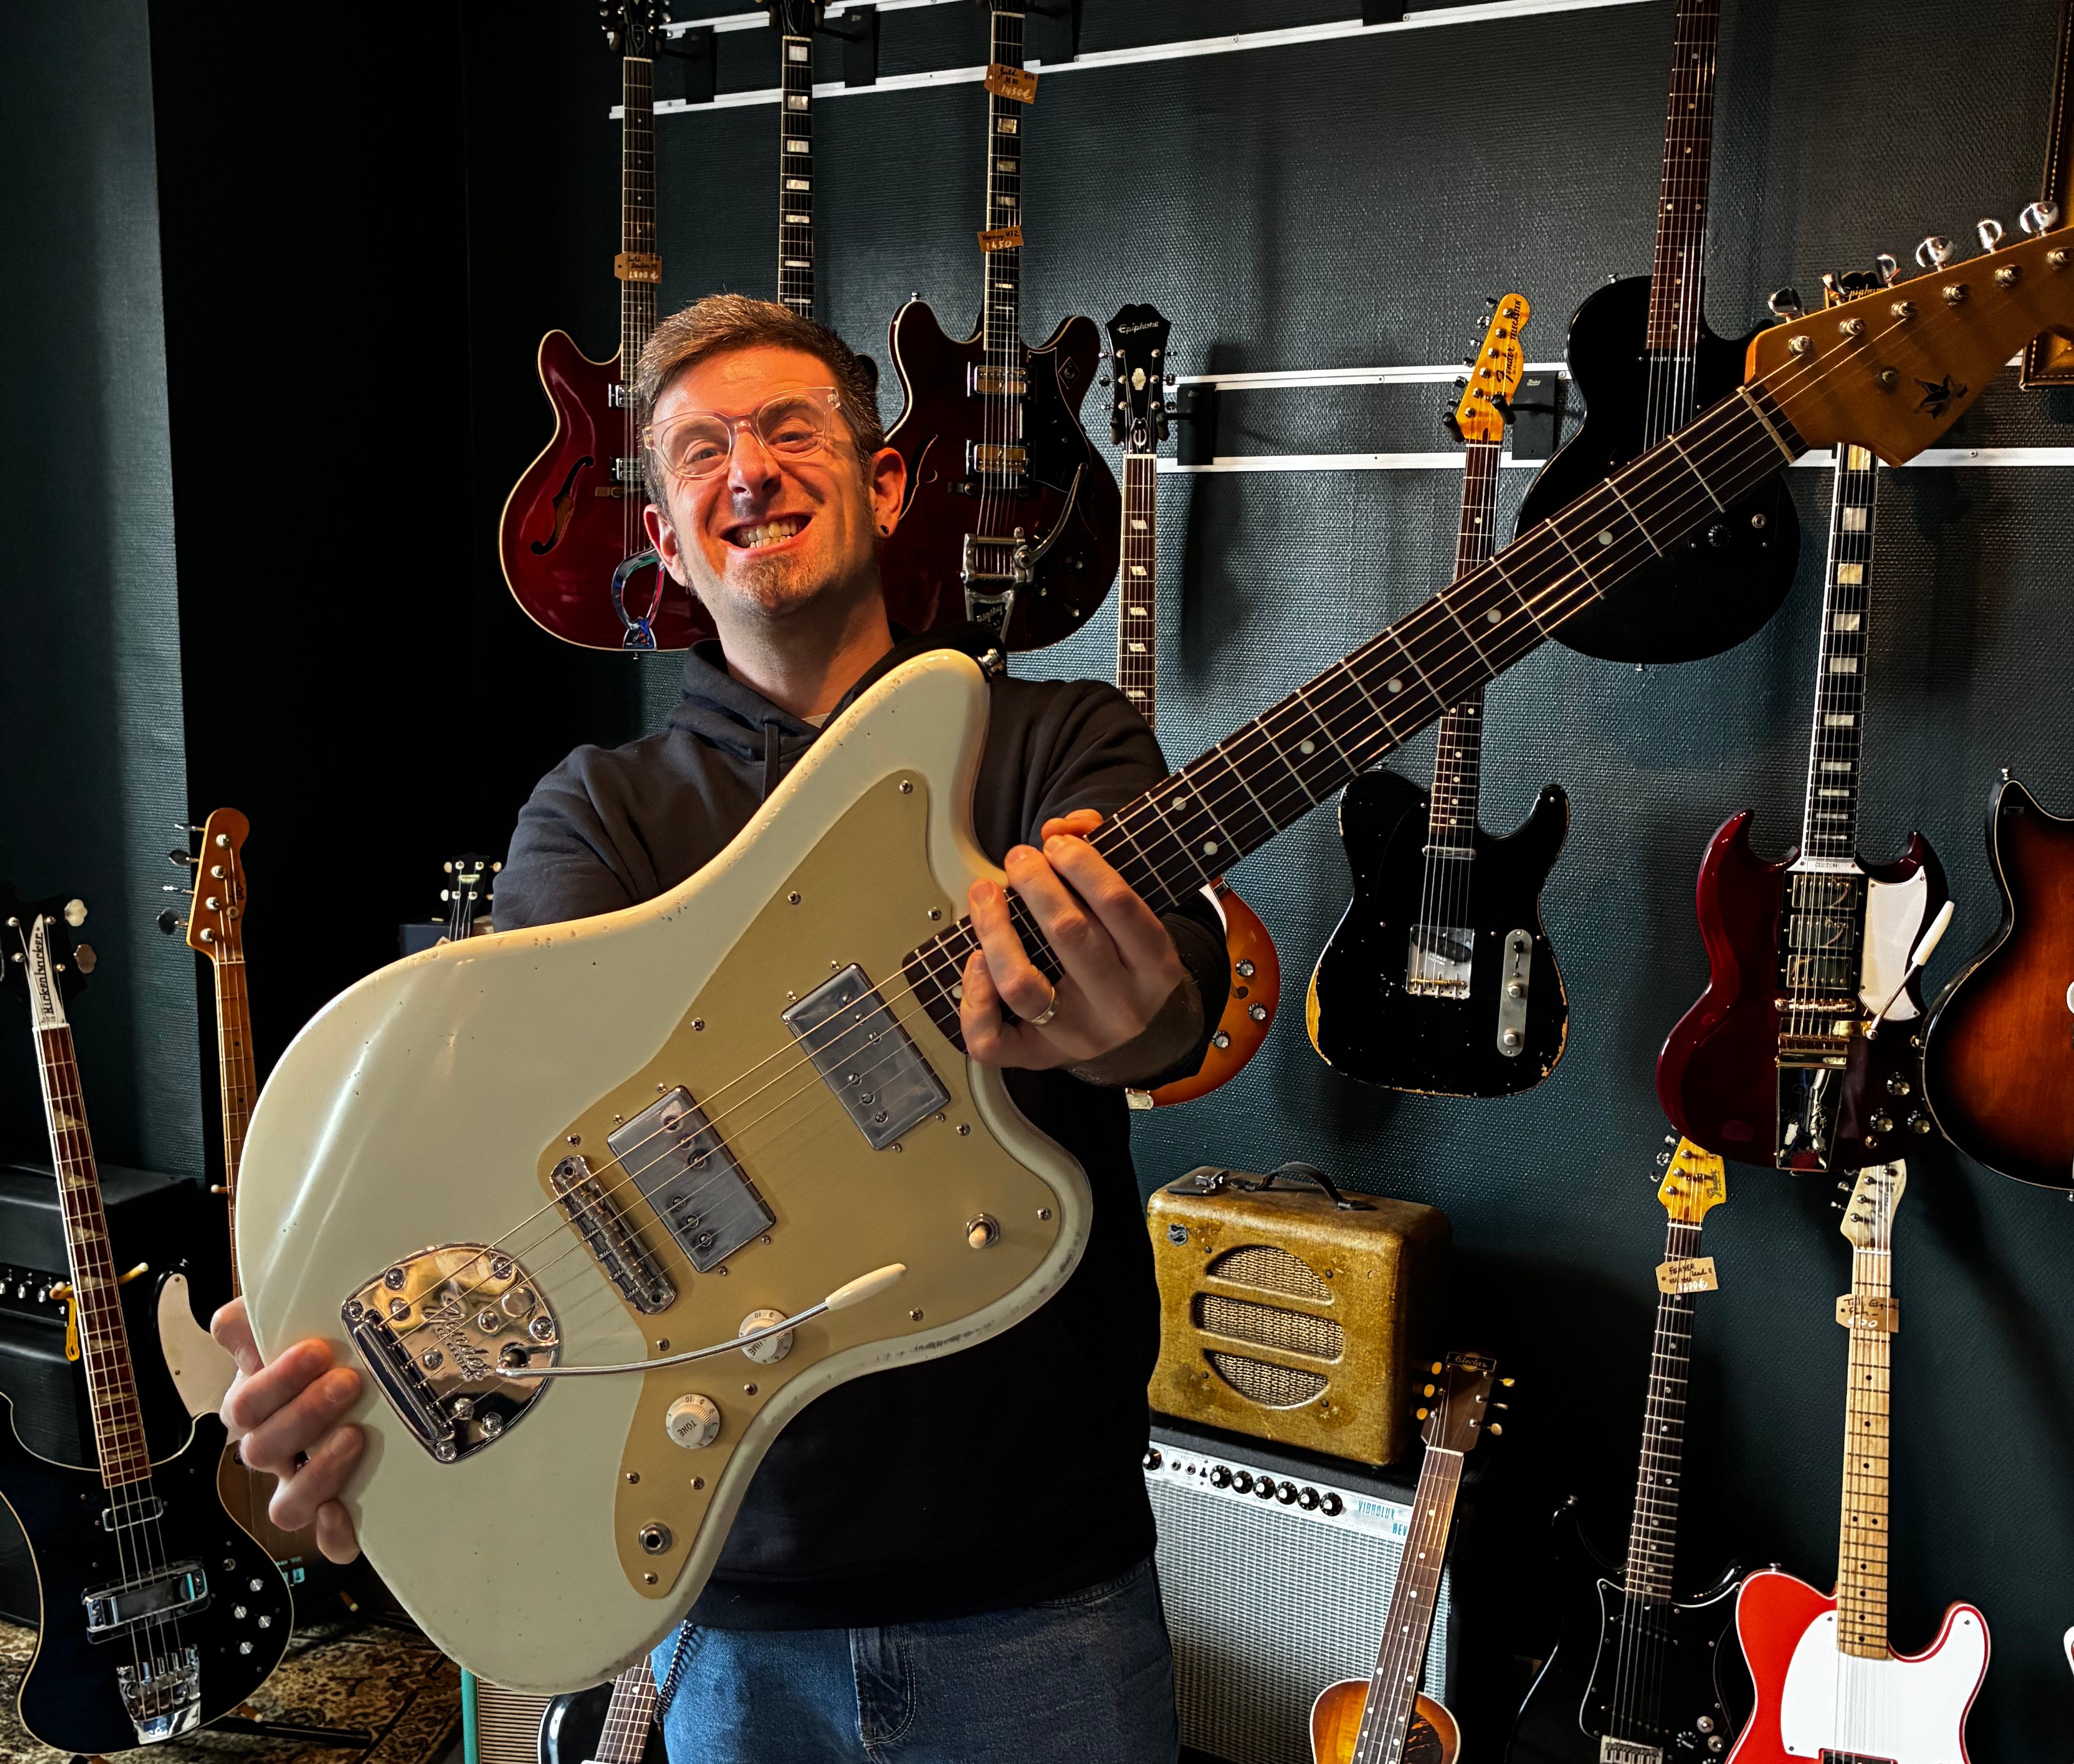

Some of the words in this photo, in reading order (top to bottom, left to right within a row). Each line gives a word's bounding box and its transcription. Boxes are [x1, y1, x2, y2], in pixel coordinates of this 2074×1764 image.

[1117, 321, 1159, 335] Epiphone
[1510, 300, 1522, 340] TELECASTER
[1496, 345, 1515, 384] Fender
[32, 931, 55, 1016] Rickenbacker
[677, 1420, 697, 1437] TONE
[1358, 1500, 1395, 1521] VIBROLUX
[1392, 1522, 1408, 1536] REV
